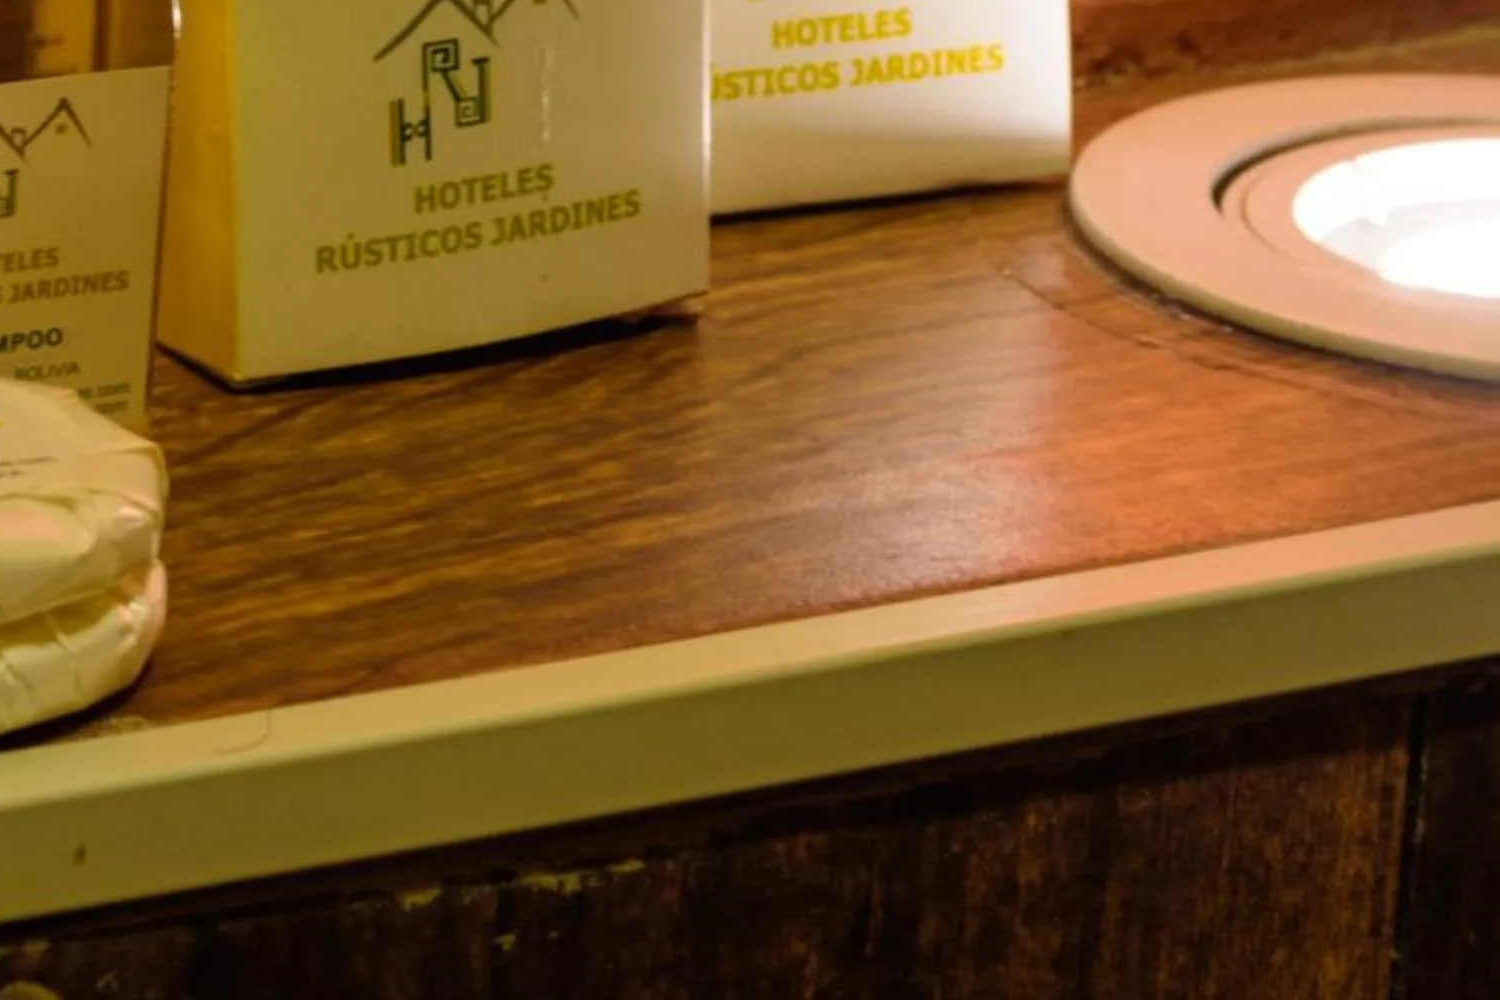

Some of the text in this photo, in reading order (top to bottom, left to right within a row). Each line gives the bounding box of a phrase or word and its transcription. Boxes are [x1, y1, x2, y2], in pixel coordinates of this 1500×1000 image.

[771, 7, 913, 49] HOTELES
[849, 44, 1005, 86] JARDINES
[414, 164, 555, 215] HOTELES
[316, 189, 642, 274] RÚSTICOS JARDINES
[8, 270, 130, 304] JARDINES
